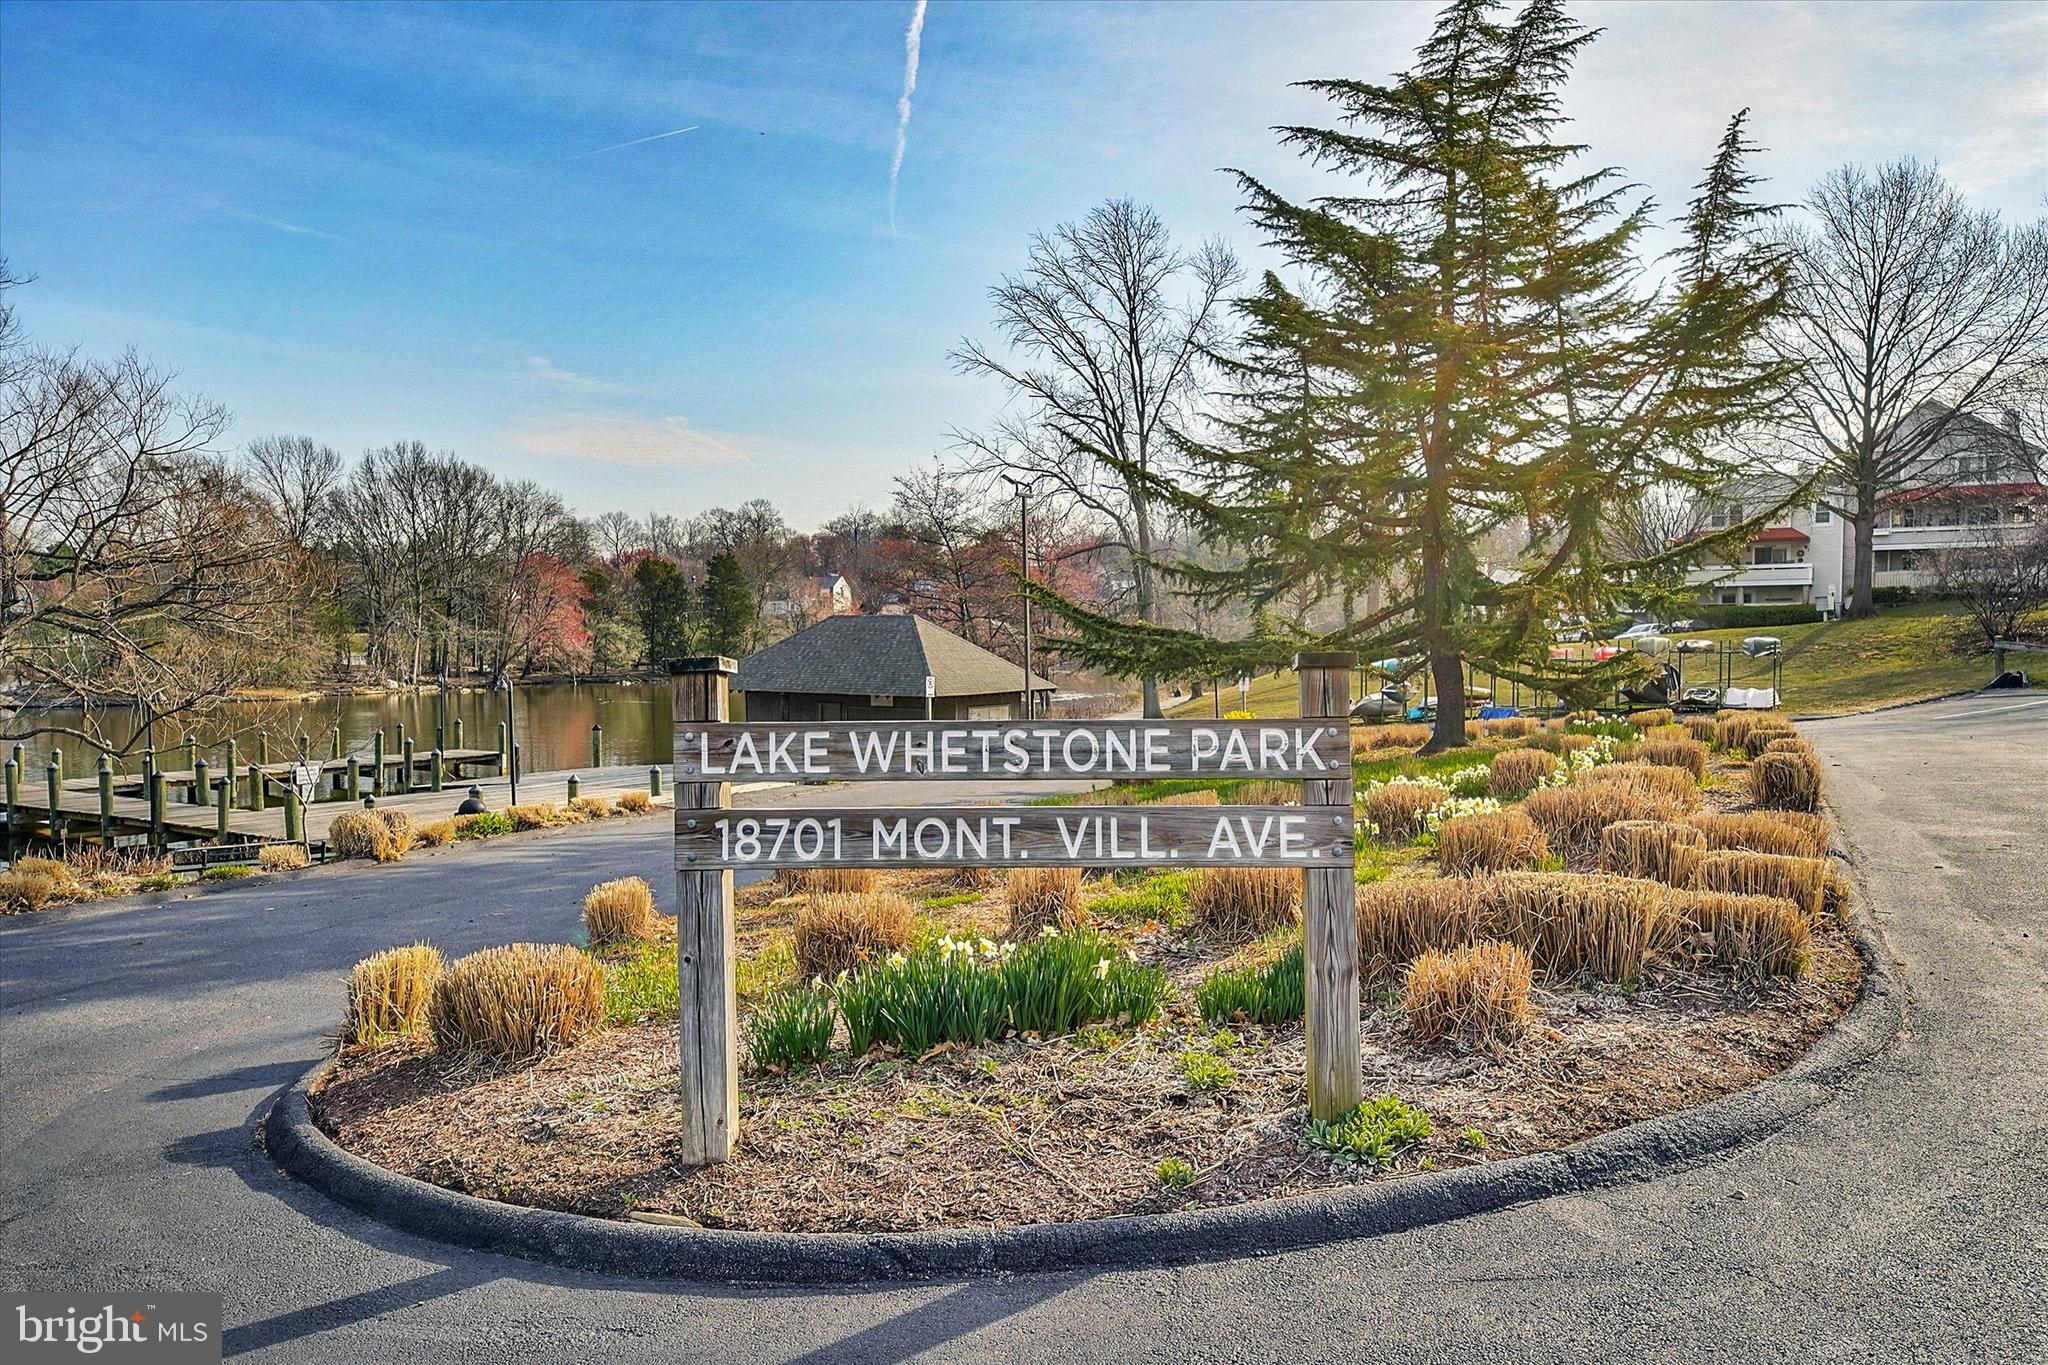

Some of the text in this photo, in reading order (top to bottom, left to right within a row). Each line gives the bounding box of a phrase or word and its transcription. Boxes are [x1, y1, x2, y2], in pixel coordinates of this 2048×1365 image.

[700, 727, 1327, 774] LAKE WHETSTONE PARK
[714, 815, 1321, 861] 18701 MONT. VILL. AVE.
